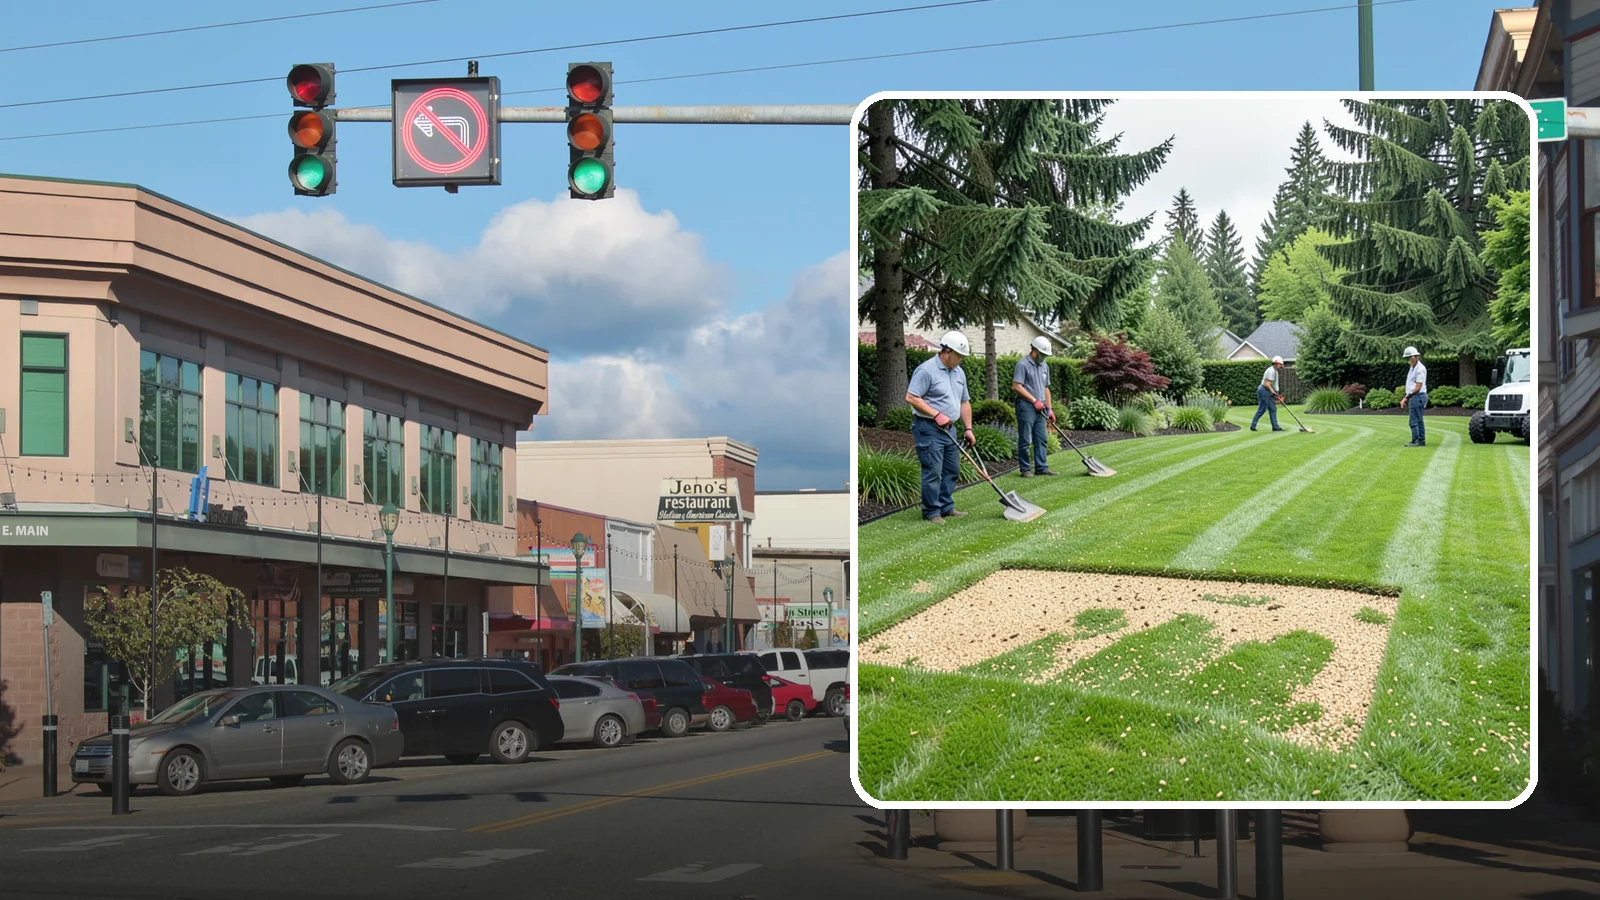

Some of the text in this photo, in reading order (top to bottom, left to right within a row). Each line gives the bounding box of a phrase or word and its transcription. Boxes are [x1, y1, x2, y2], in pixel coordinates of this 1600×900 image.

[669, 480, 728, 495] Jeno's
[664, 496, 731, 509] restaurant
[659, 510, 681, 519] Italian
[686, 509, 714, 519] American
[714, 509, 738, 519] Cuisine
[2, 525, 49, 536] E. MAIN
[797, 607, 828, 616] Street
